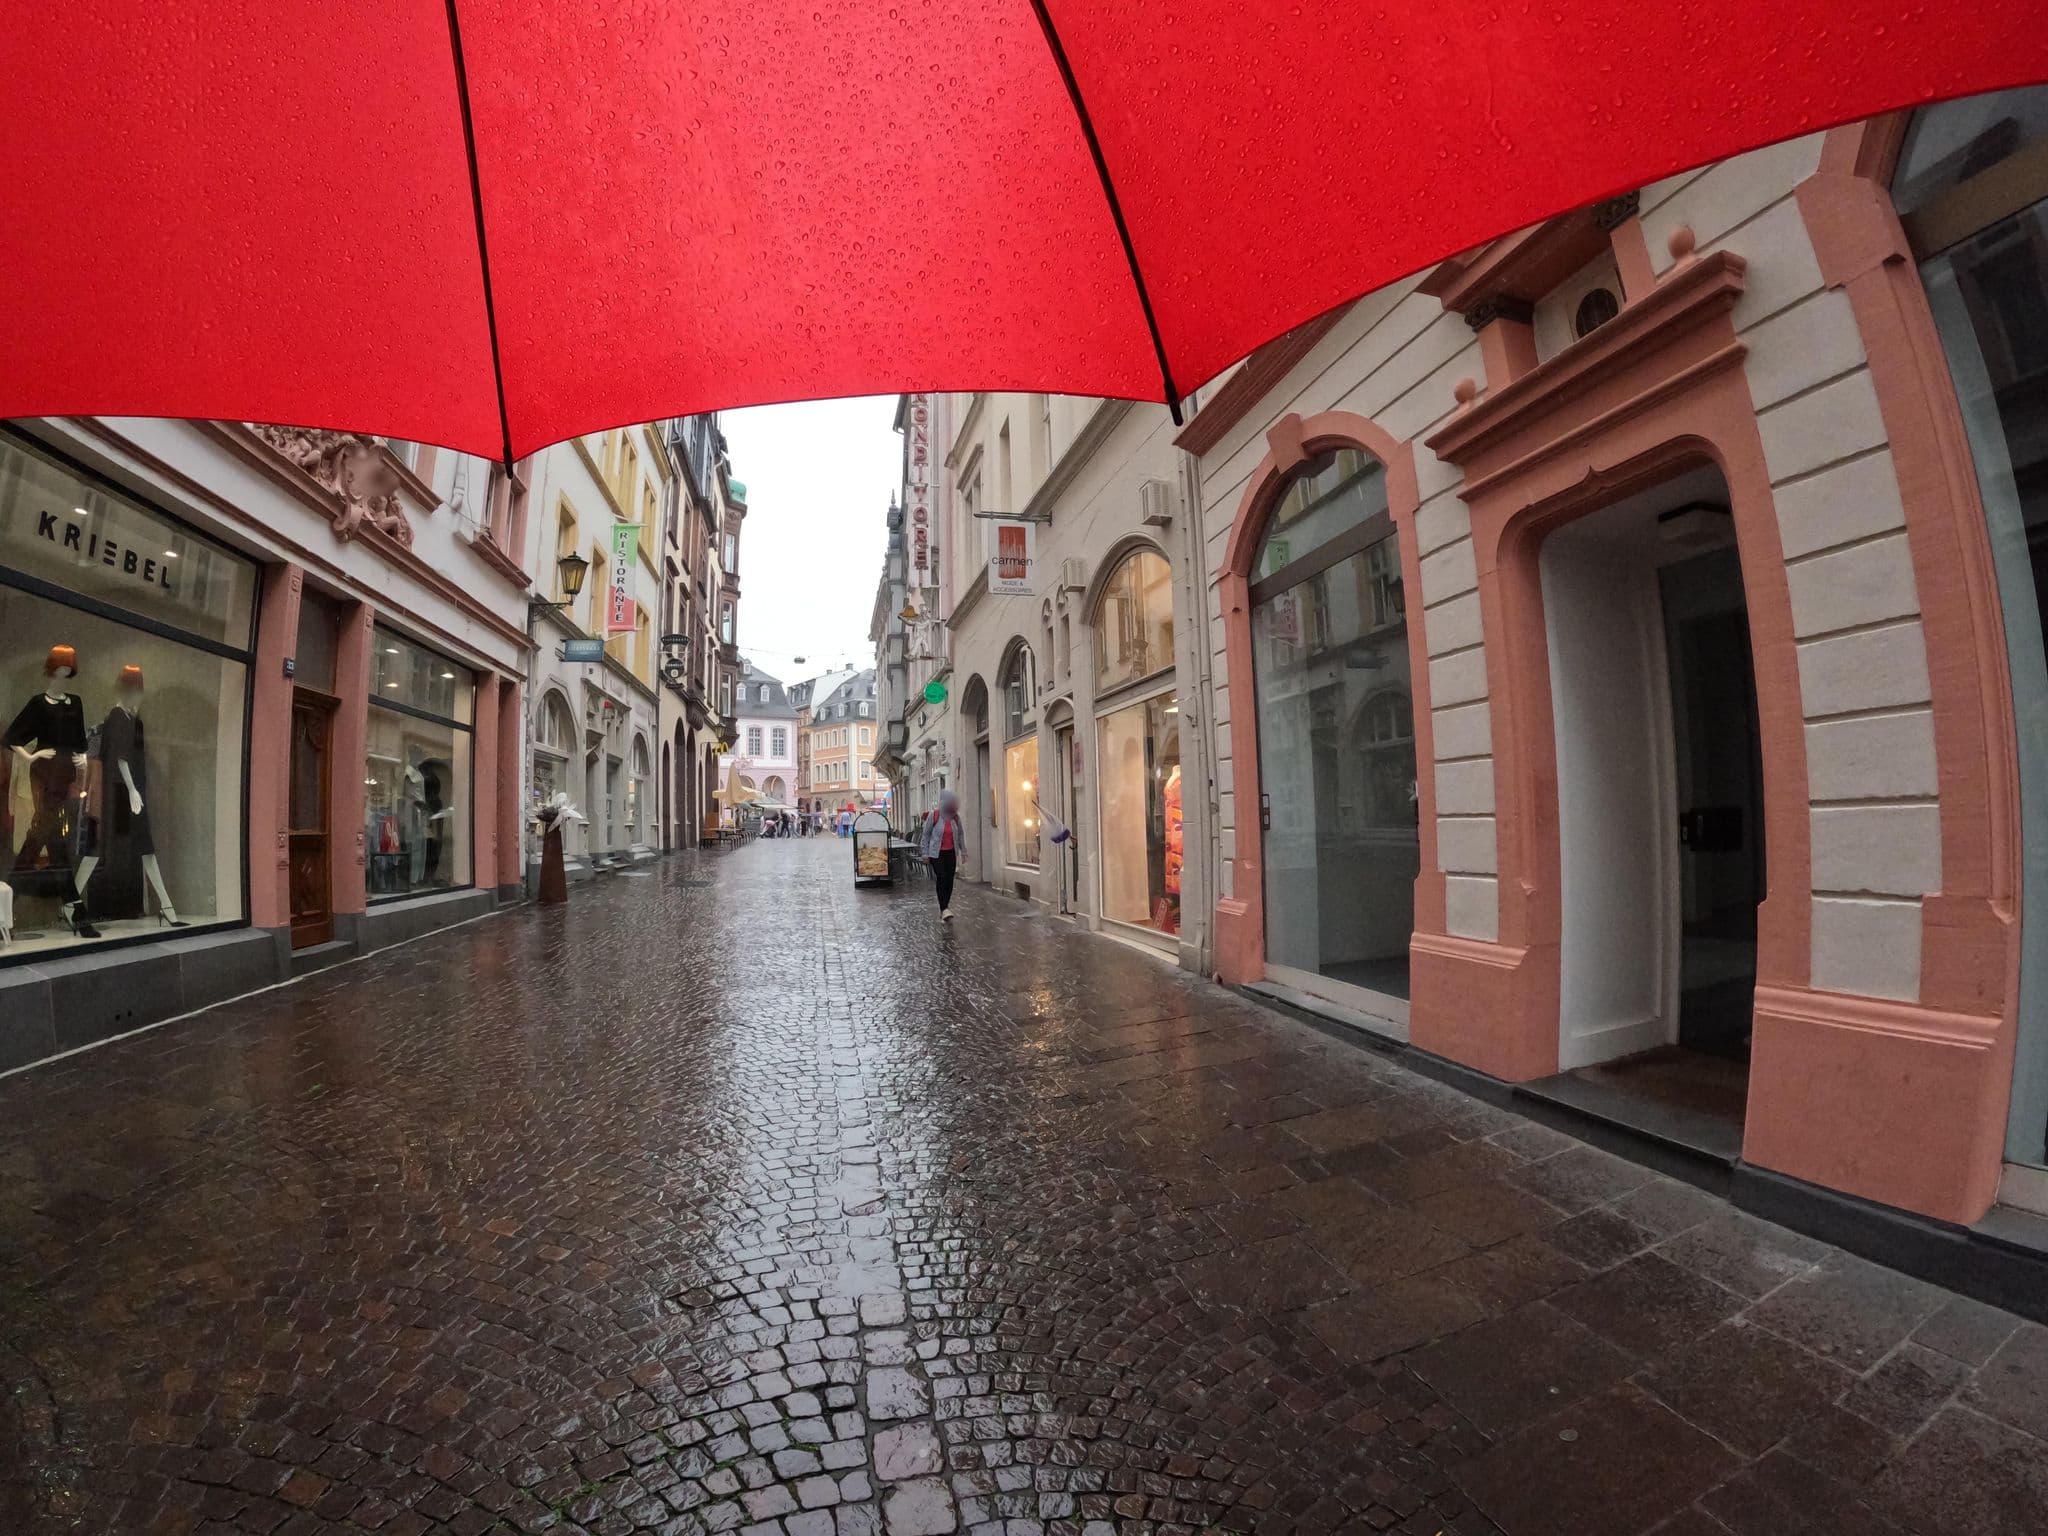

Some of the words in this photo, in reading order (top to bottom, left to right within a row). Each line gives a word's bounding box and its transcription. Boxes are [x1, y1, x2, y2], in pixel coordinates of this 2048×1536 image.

[38, 510, 170, 589] KRIEBEL
[615, 531, 628, 622] RISTORANTE
[991, 556, 1033, 567] carmen
